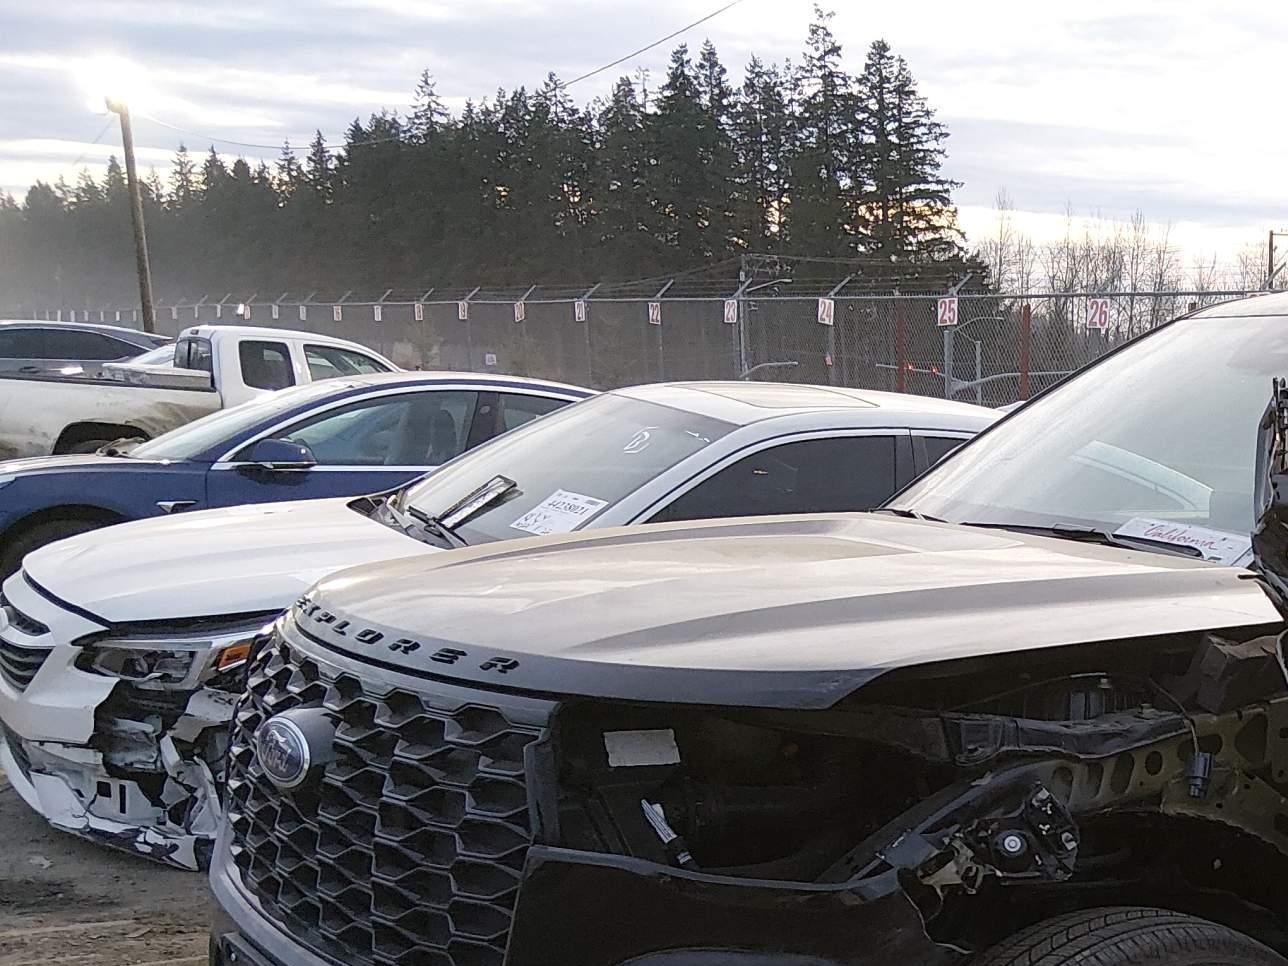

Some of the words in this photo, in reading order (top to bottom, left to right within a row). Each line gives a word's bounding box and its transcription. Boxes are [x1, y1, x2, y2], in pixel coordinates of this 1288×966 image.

[650, 303, 660, 323] 22
[725, 301, 736, 321] 23
[820, 300, 832, 323] 24
[939, 299, 956, 324] 25
[1088, 300, 1107, 327] 26
